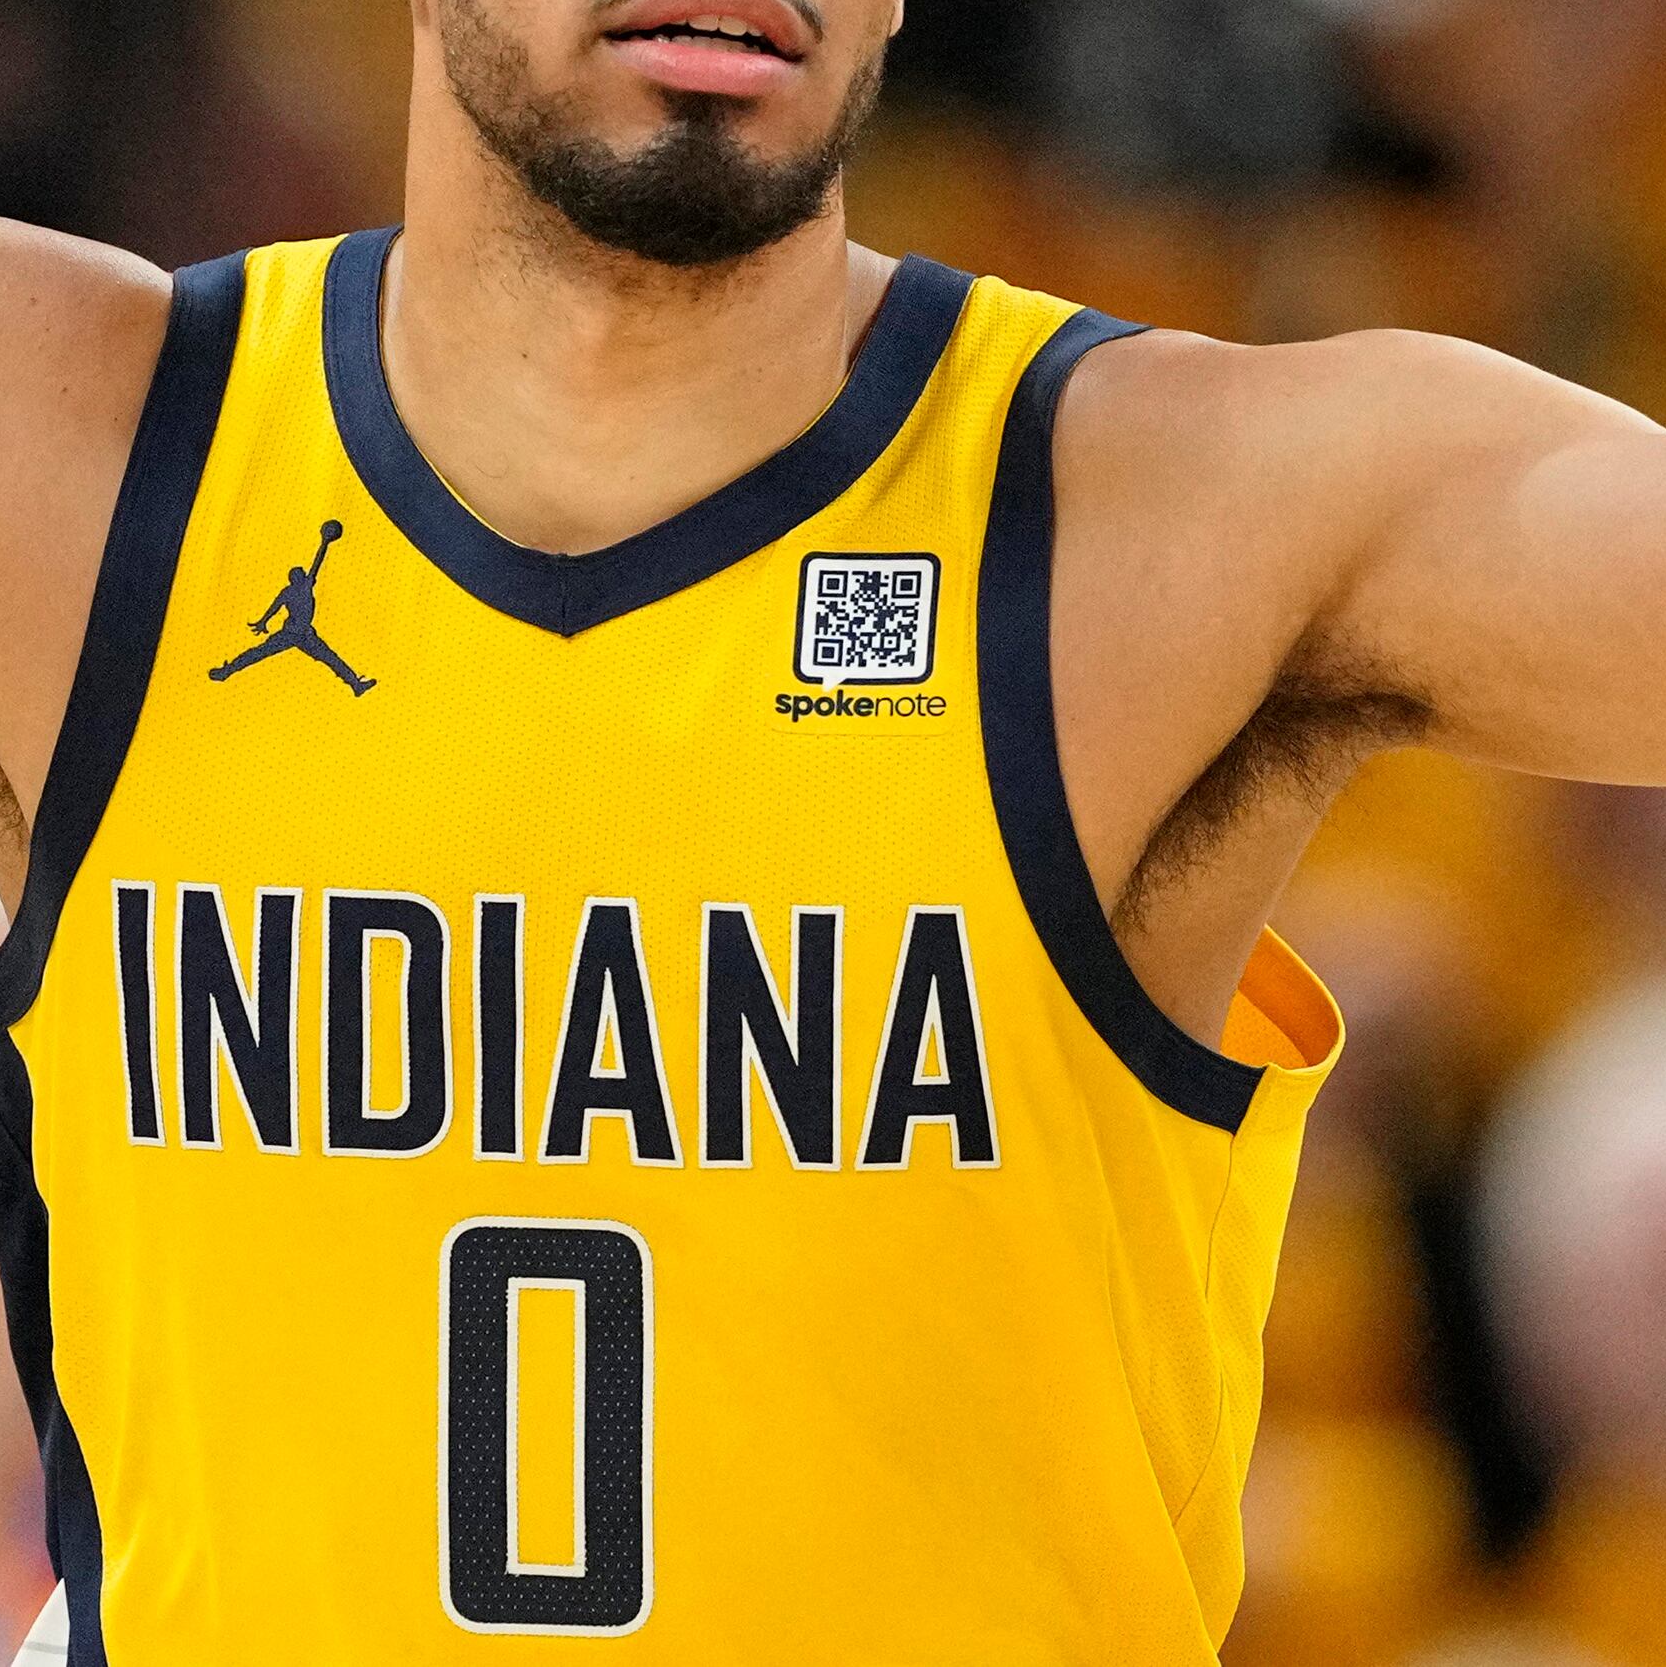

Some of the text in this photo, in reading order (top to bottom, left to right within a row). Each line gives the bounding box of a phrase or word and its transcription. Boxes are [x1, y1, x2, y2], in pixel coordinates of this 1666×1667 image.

[775, 690, 946, 722] spokenote
[112, 880, 1002, 1171] INDIANA
[438, 1217, 654, 1637] 0
